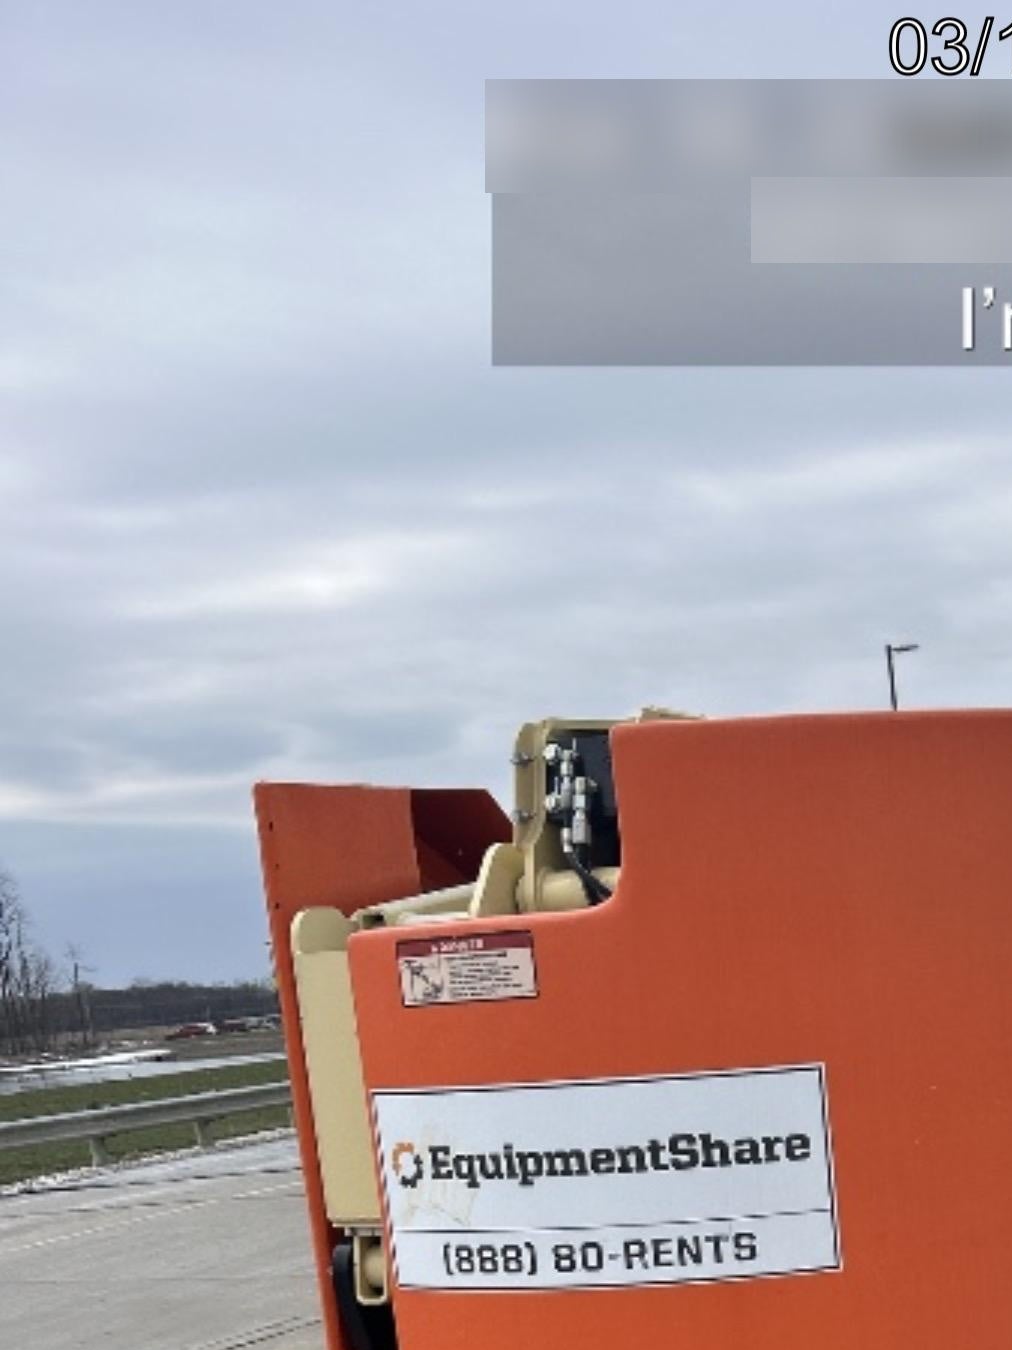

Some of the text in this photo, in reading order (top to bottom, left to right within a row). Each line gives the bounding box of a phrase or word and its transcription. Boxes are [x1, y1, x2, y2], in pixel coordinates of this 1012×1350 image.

[428, 1131, 811, 1188] EquipmentShare
[442, 1231, 759, 1276] (888) 80-RENTS
